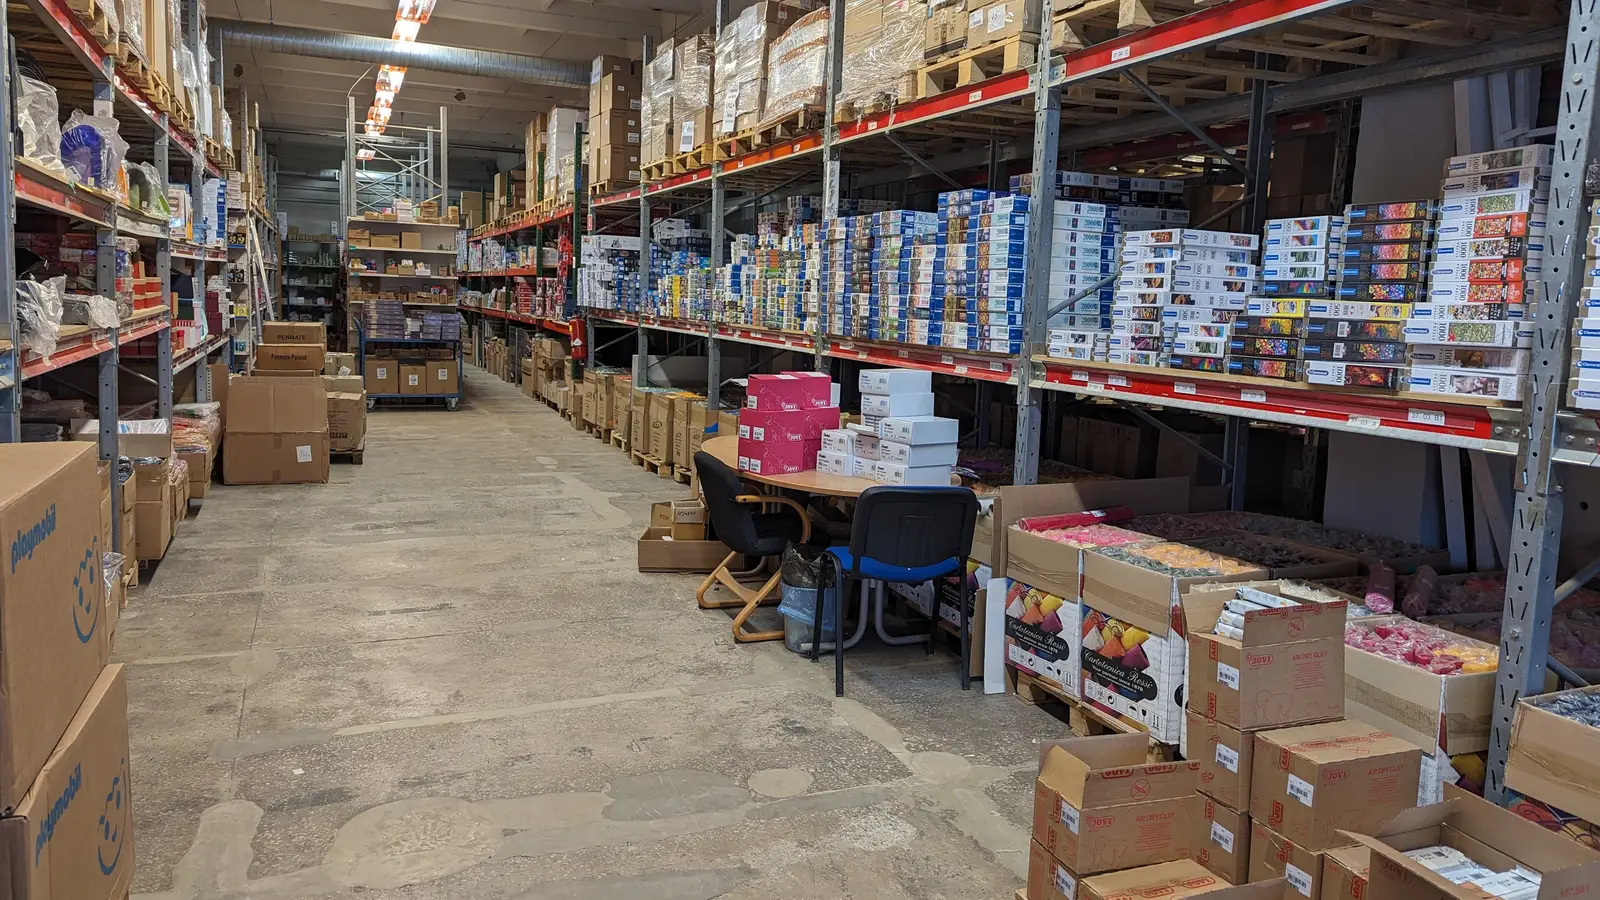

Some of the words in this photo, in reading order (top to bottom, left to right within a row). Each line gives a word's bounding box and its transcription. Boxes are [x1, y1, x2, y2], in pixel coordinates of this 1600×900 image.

[1438, 323, 1447, 341] 1000
[1444, 349, 1452, 368] 1000
[1438, 374, 1448, 393] 1000
[11, 503, 56, 575] playmobil
[1009, 618, 1043, 642] Cartotecnica
[1045, 634, 1066, 650] Rossi
[1084, 650, 1125, 677] Cartotecnica
[1127, 670, 1153, 689] Rossi
[1102, 671, 1118, 680] partner
[1326, 772, 1347, 780] JOVI
[36, 762, 82, 868] playmobil
[1092, 818, 1112, 826] JOVI
